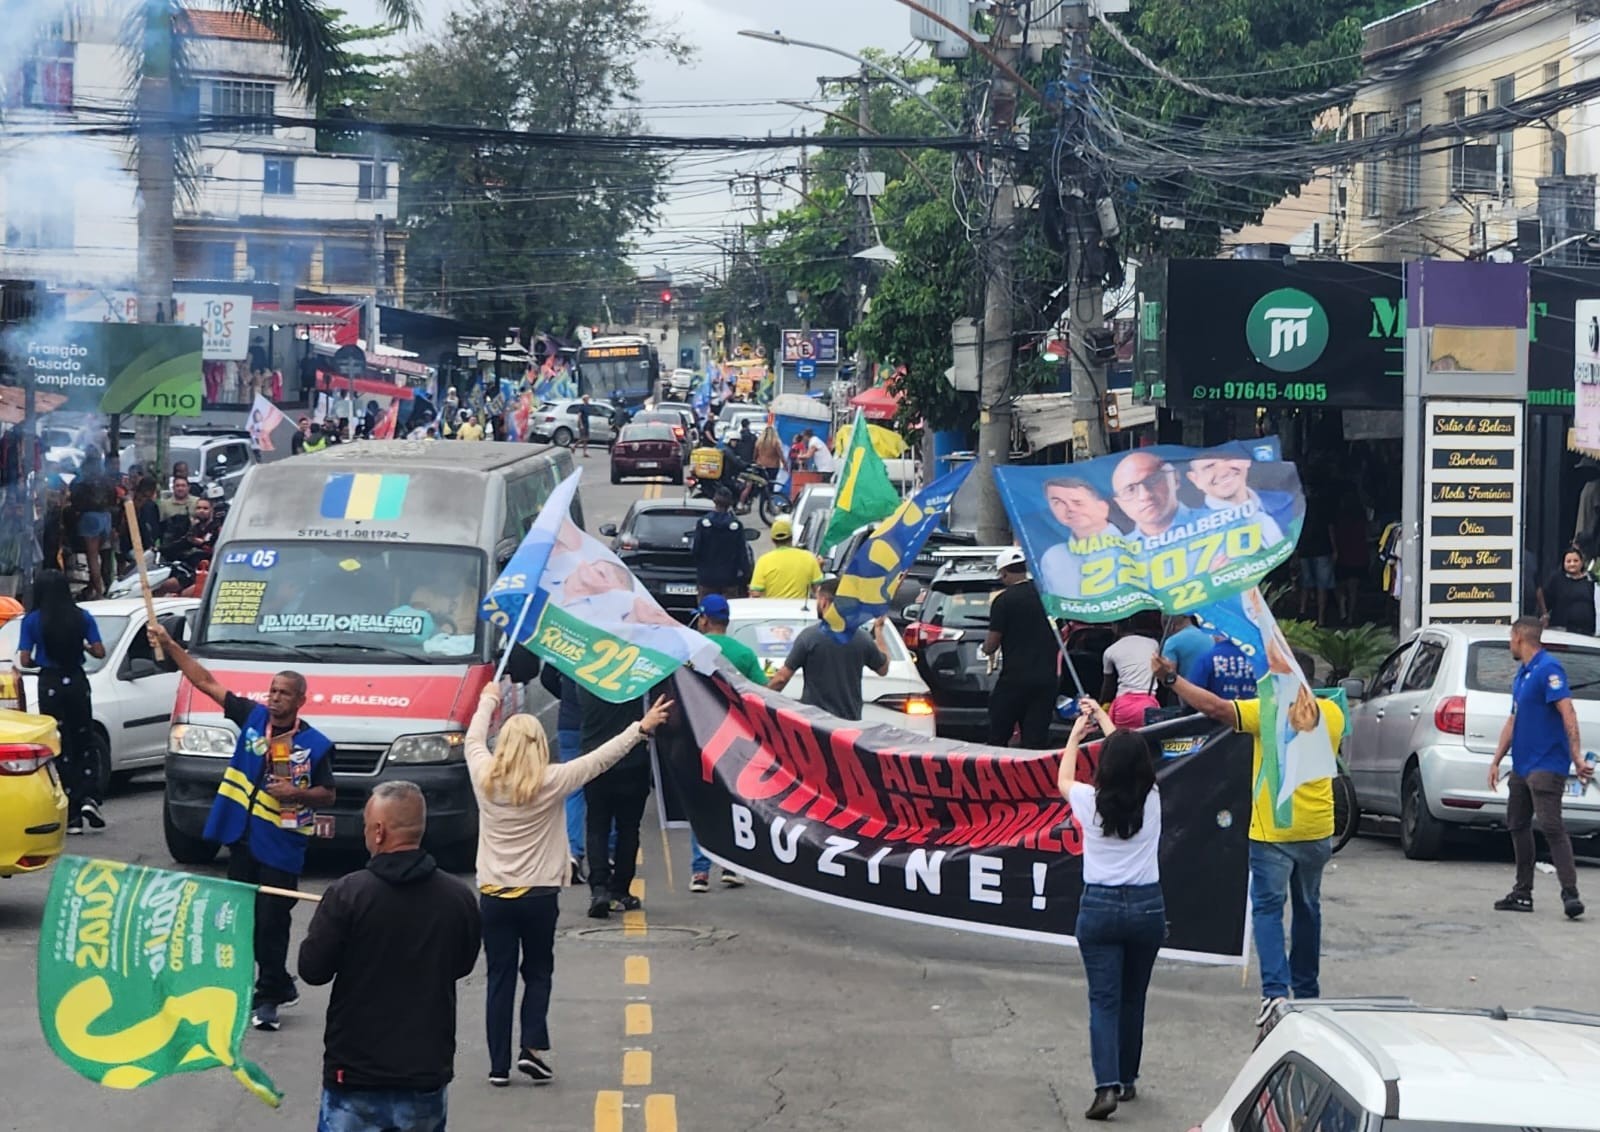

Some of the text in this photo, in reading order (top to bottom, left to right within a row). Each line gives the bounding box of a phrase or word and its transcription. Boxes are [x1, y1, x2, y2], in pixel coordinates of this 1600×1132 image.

[27, 341, 88, 359] Frangão
[27, 356, 81, 371] Assado
[34, 373, 106, 388] ompletão
[1209, 382, 1327, 401] 21 97645-4095
[1436, 418, 1512, 432] Salão de Beleza
[1448, 452, 1498, 466] Barbearia
[1433, 485, 1512, 500] Moda Feminina
[1143, 500, 1254, 550] GUALBERTO
[1459, 518, 1485, 535] Ótica
[251, 549, 277, 567] 05
[1080, 522, 1263, 597] 22070
[1442, 551, 1502, 568] Mega Hair
[1210, 556, 1267, 587] Douglas
[1167, 580, 1209, 611] 22
[1446, 586, 1496, 601] Esmalteria
[349, 614, 423, 634] REALENGO
[575, 639, 640, 690] 22
[331, 694, 410, 707] REALENGO
[876, 740, 1104, 801] ALEXAND
[883, 793, 941, 845] DE
